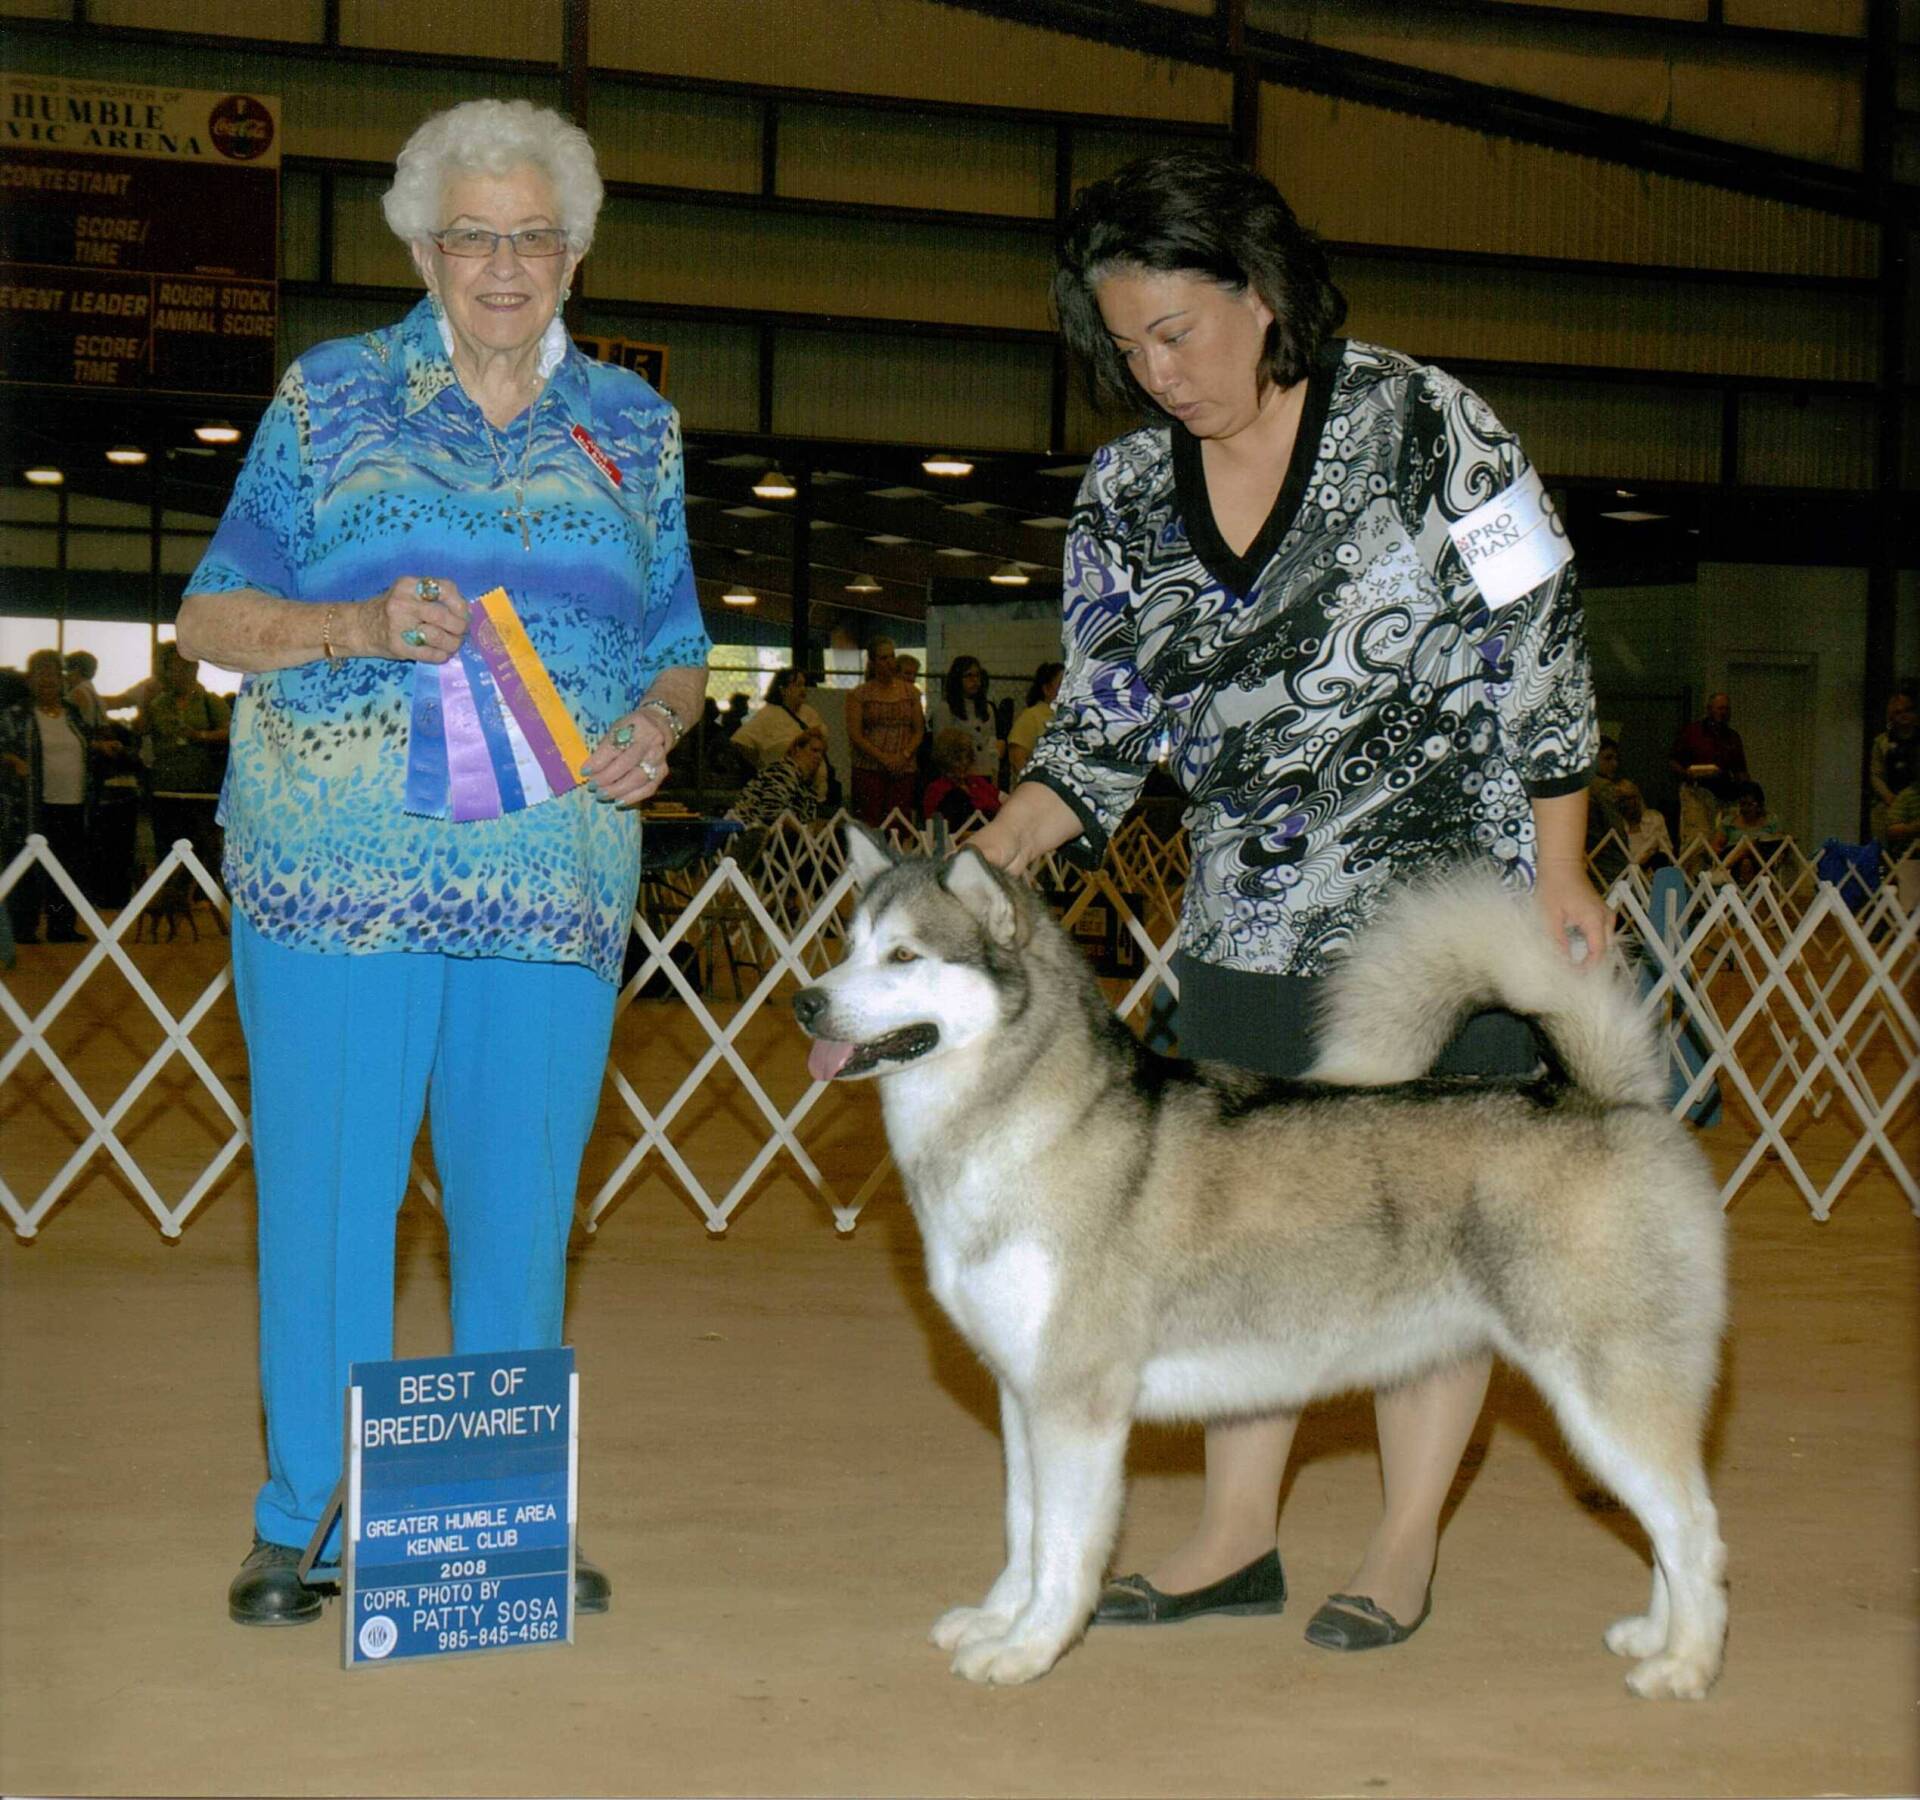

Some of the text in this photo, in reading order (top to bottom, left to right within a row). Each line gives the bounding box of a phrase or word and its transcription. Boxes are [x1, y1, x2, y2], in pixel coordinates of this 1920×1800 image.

[12, 93, 165, 129] HUMBLE
[84, 127, 203, 155] ARENA
[0, 164, 131, 196] CONTESTANT
[75, 240, 120, 265] TIME
[70, 290, 148, 317] LEADER
[159, 282, 272, 312] ROUGH STOCK
[155, 309, 275, 337] ANIMAL SCORE
[73, 359, 119, 384] TIME
[1466, 524, 1520, 565] PLAN
[1468, 513, 1512, 546] PRO
[400, 1367, 527, 1405] BEST OF
[364, 1404, 561, 1448] BREED/VARIETY
[366, 1504, 557, 1538] GREATER HUMBLE AREA
[407, 1529, 518, 1556] KENNEL CLUB
[440, 1560, 487, 1579] 2008
[364, 1580, 501, 1612] COPR. PHOTO BY
[413, 1597, 559, 1632] PATTY SOSA
[438, 1621, 559, 1651] 985-845-4562
